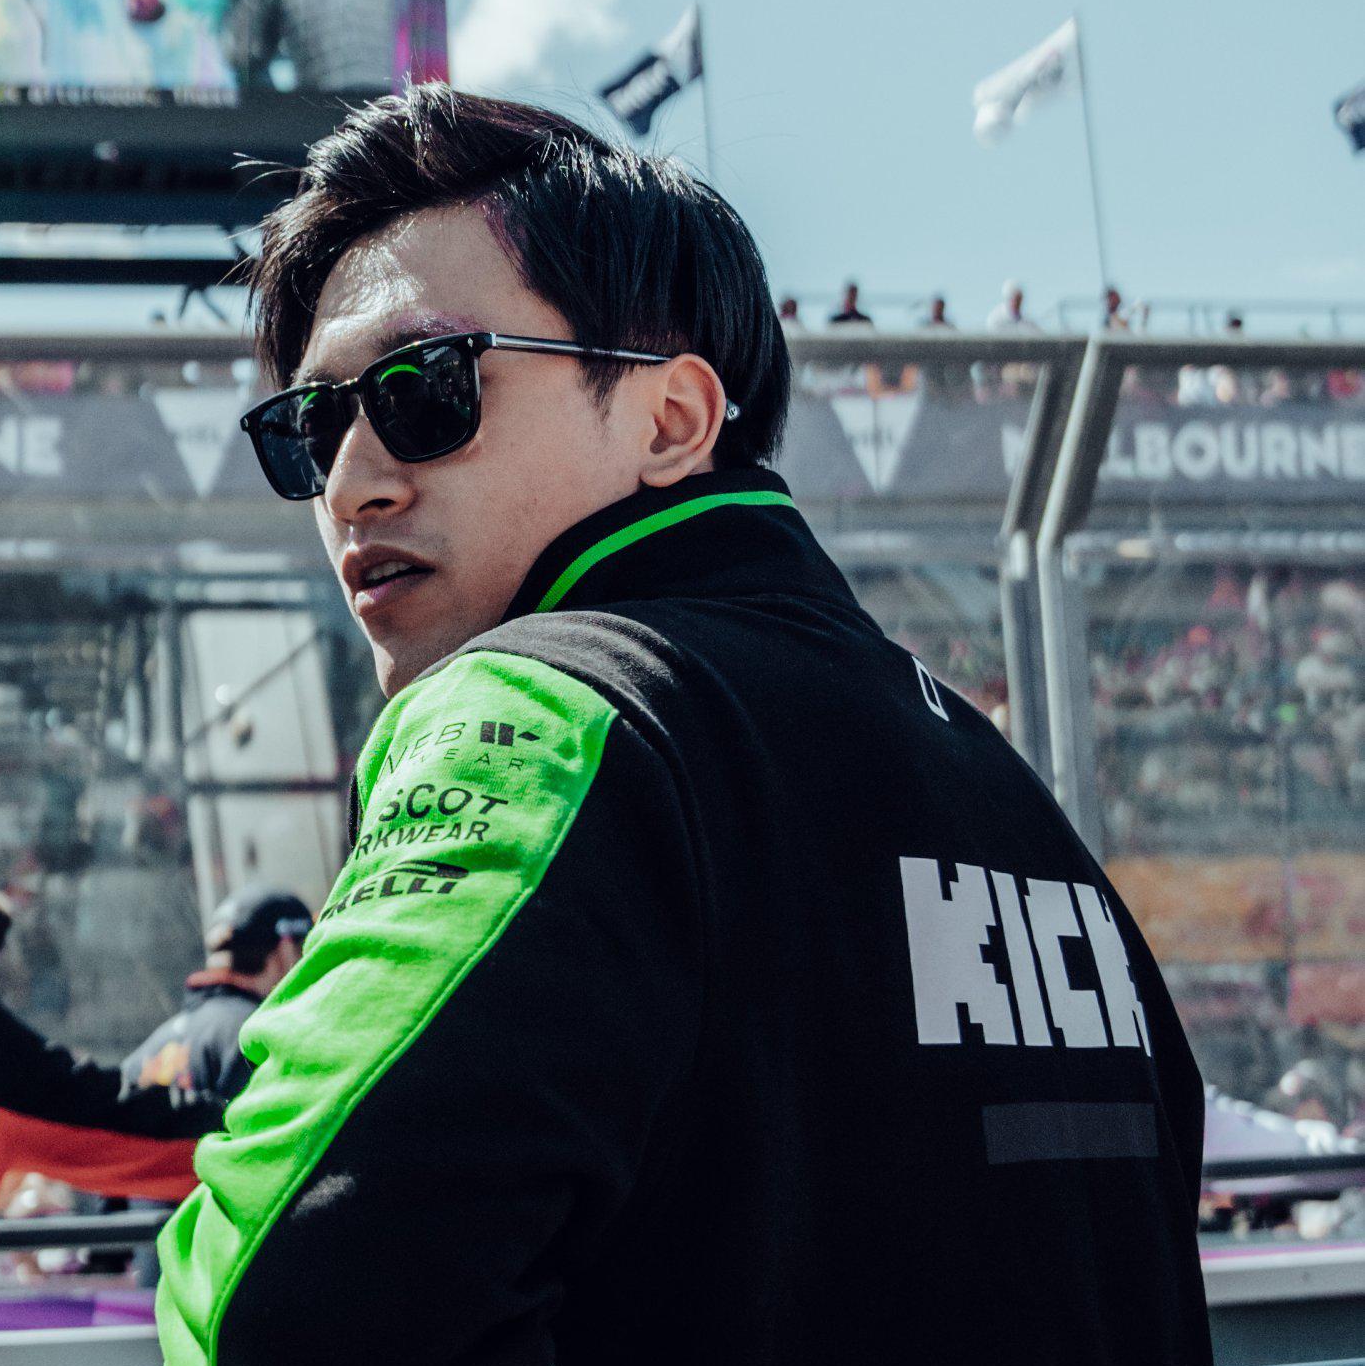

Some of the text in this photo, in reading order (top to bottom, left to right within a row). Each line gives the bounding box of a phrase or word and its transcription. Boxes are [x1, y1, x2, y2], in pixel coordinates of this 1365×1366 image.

[1001, 421, 1365, 482] LBOURNE
[378, 783, 508, 822] SCOT
[355, 821, 490, 860] RKWEAR
